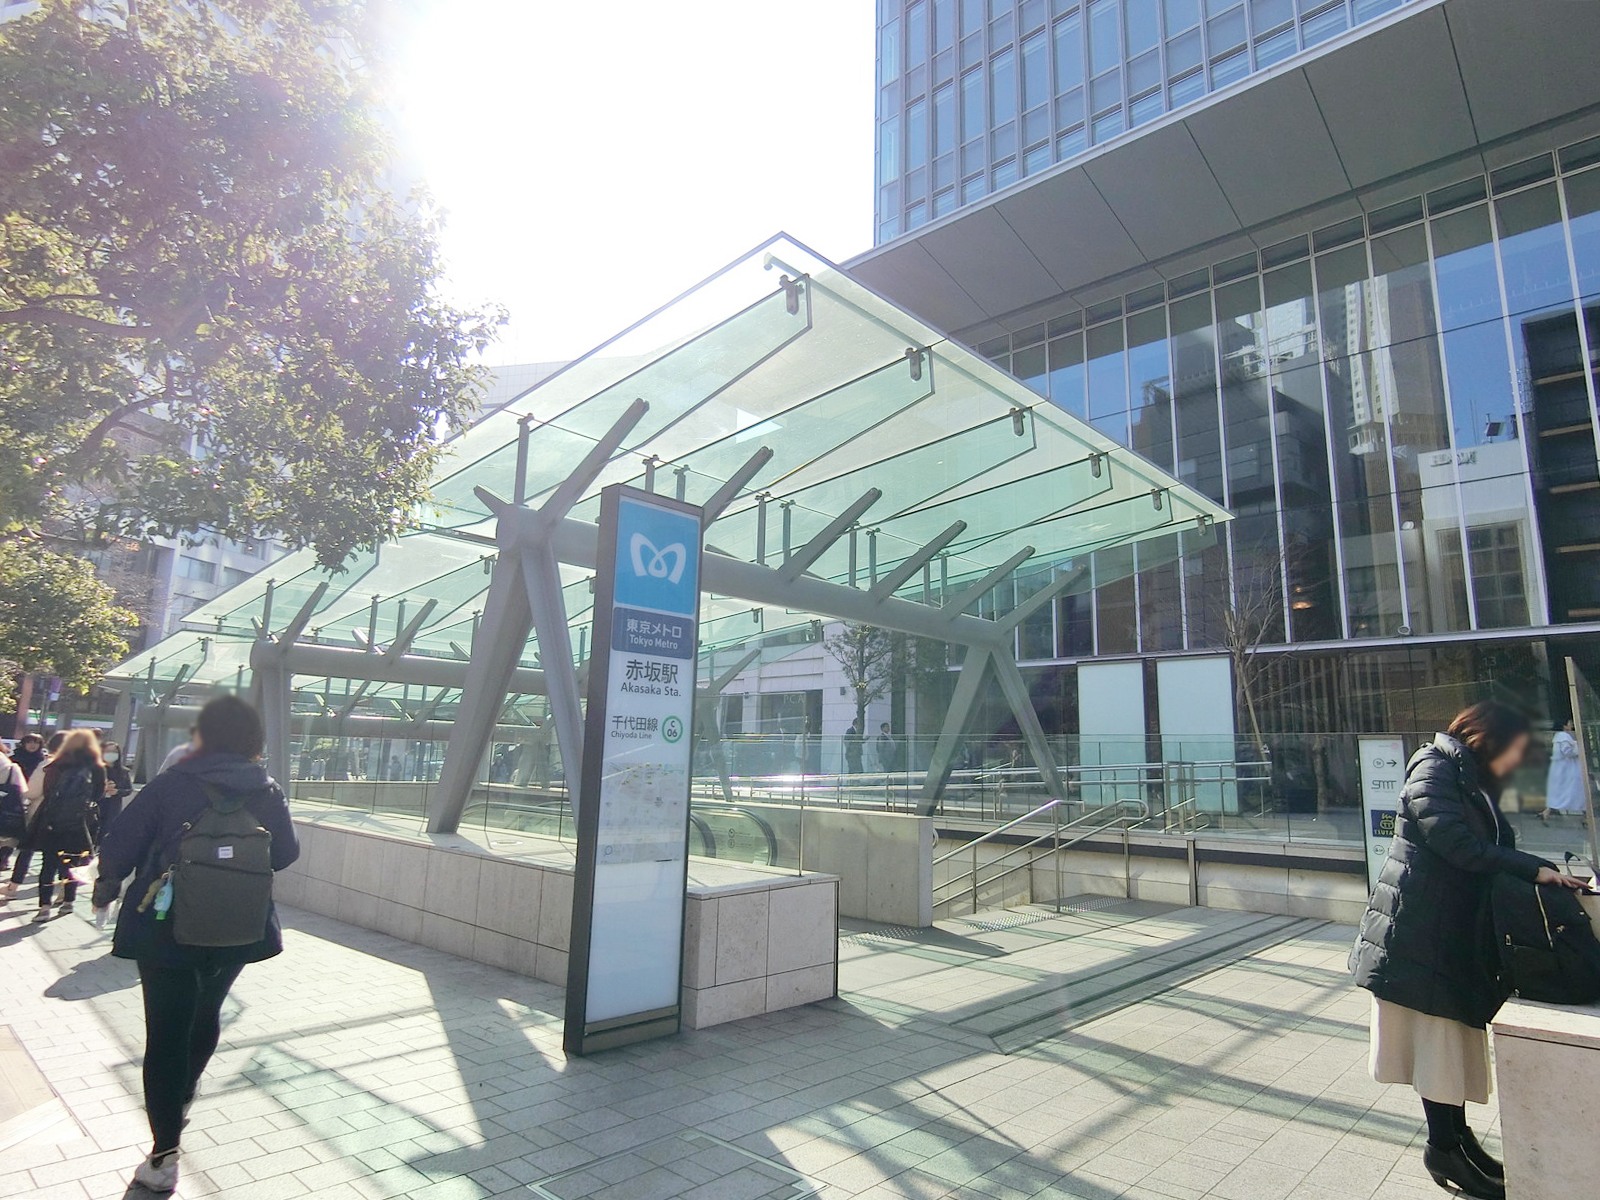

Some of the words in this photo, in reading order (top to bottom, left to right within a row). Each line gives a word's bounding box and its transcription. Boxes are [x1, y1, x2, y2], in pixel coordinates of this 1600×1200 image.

[626, 618, 682, 639] 東京メトロ
[629, 634, 653, 648] Tokyo
[654, 637, 678, 650] Metro
[625, 659, 679, 685] 赤坂駅
[620, 682, 662, 696] Akasaka
[664, 686, 682, 697] Sta.
[611, 715, 659, 732] 千代田線
[670, 720, 676, 728] C
[611, 730, 638, 740] Chiyoda
[639, 732, 653, 740] Line
[666, 728, 678, 738] 06
